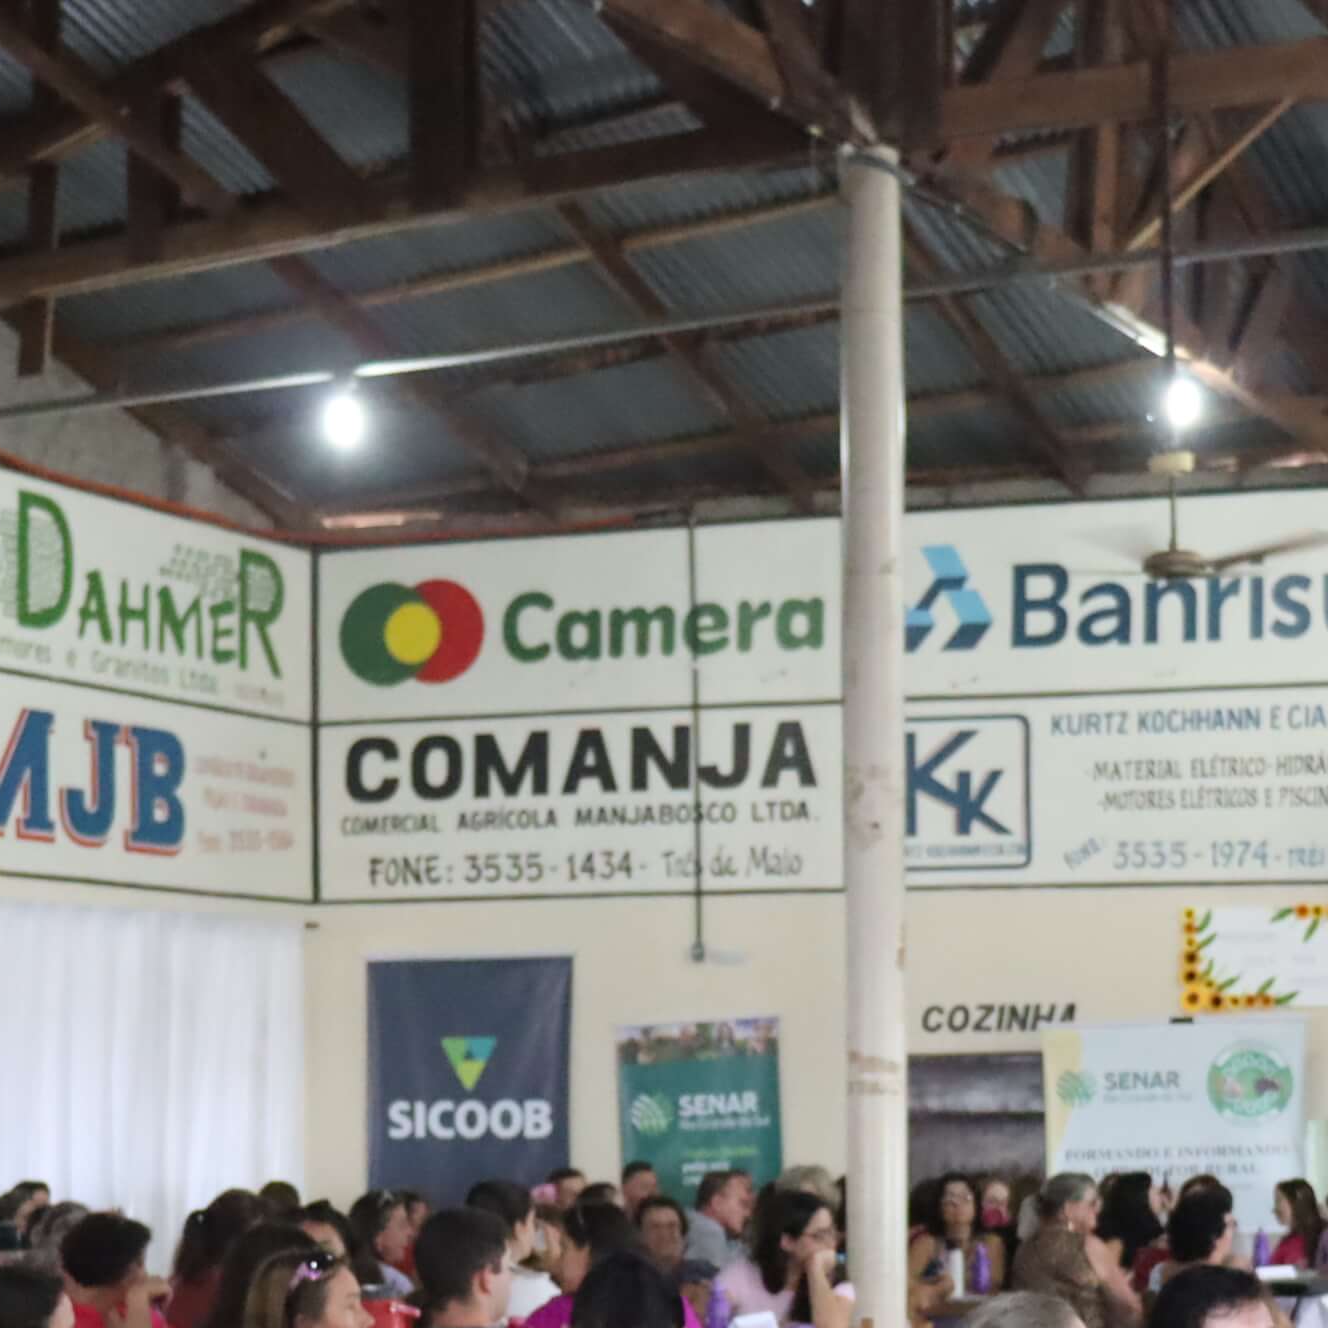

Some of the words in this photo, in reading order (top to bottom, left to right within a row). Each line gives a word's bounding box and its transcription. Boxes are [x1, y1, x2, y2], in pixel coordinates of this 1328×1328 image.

[17, 488, 286, 680] DAHMER
[501, 590, 826, 665] Camera
[1049, 711, 1130, 737] KURTZ
[1136, 706, 1261, 734] KOCHHANN
[1269, 705, 1282, 731] E
[344, 720, 819, 804] COMANJA
[341, 813, 440, 837] COMERCIAL
[573, 801, 738, 828] MANJABOSCO
[368, 856, 454, 887] FONE:
[709, 845, 738, 877] de
[742, 843, 804, 877] Maio
[921, 1002, 1077, 1033] COZINHA
[1103, 1069, 1181, 1091] SENAR
[387, 1098, 555, 1141] SICOOB
[678, 1091, 759, 1118] SENAR
